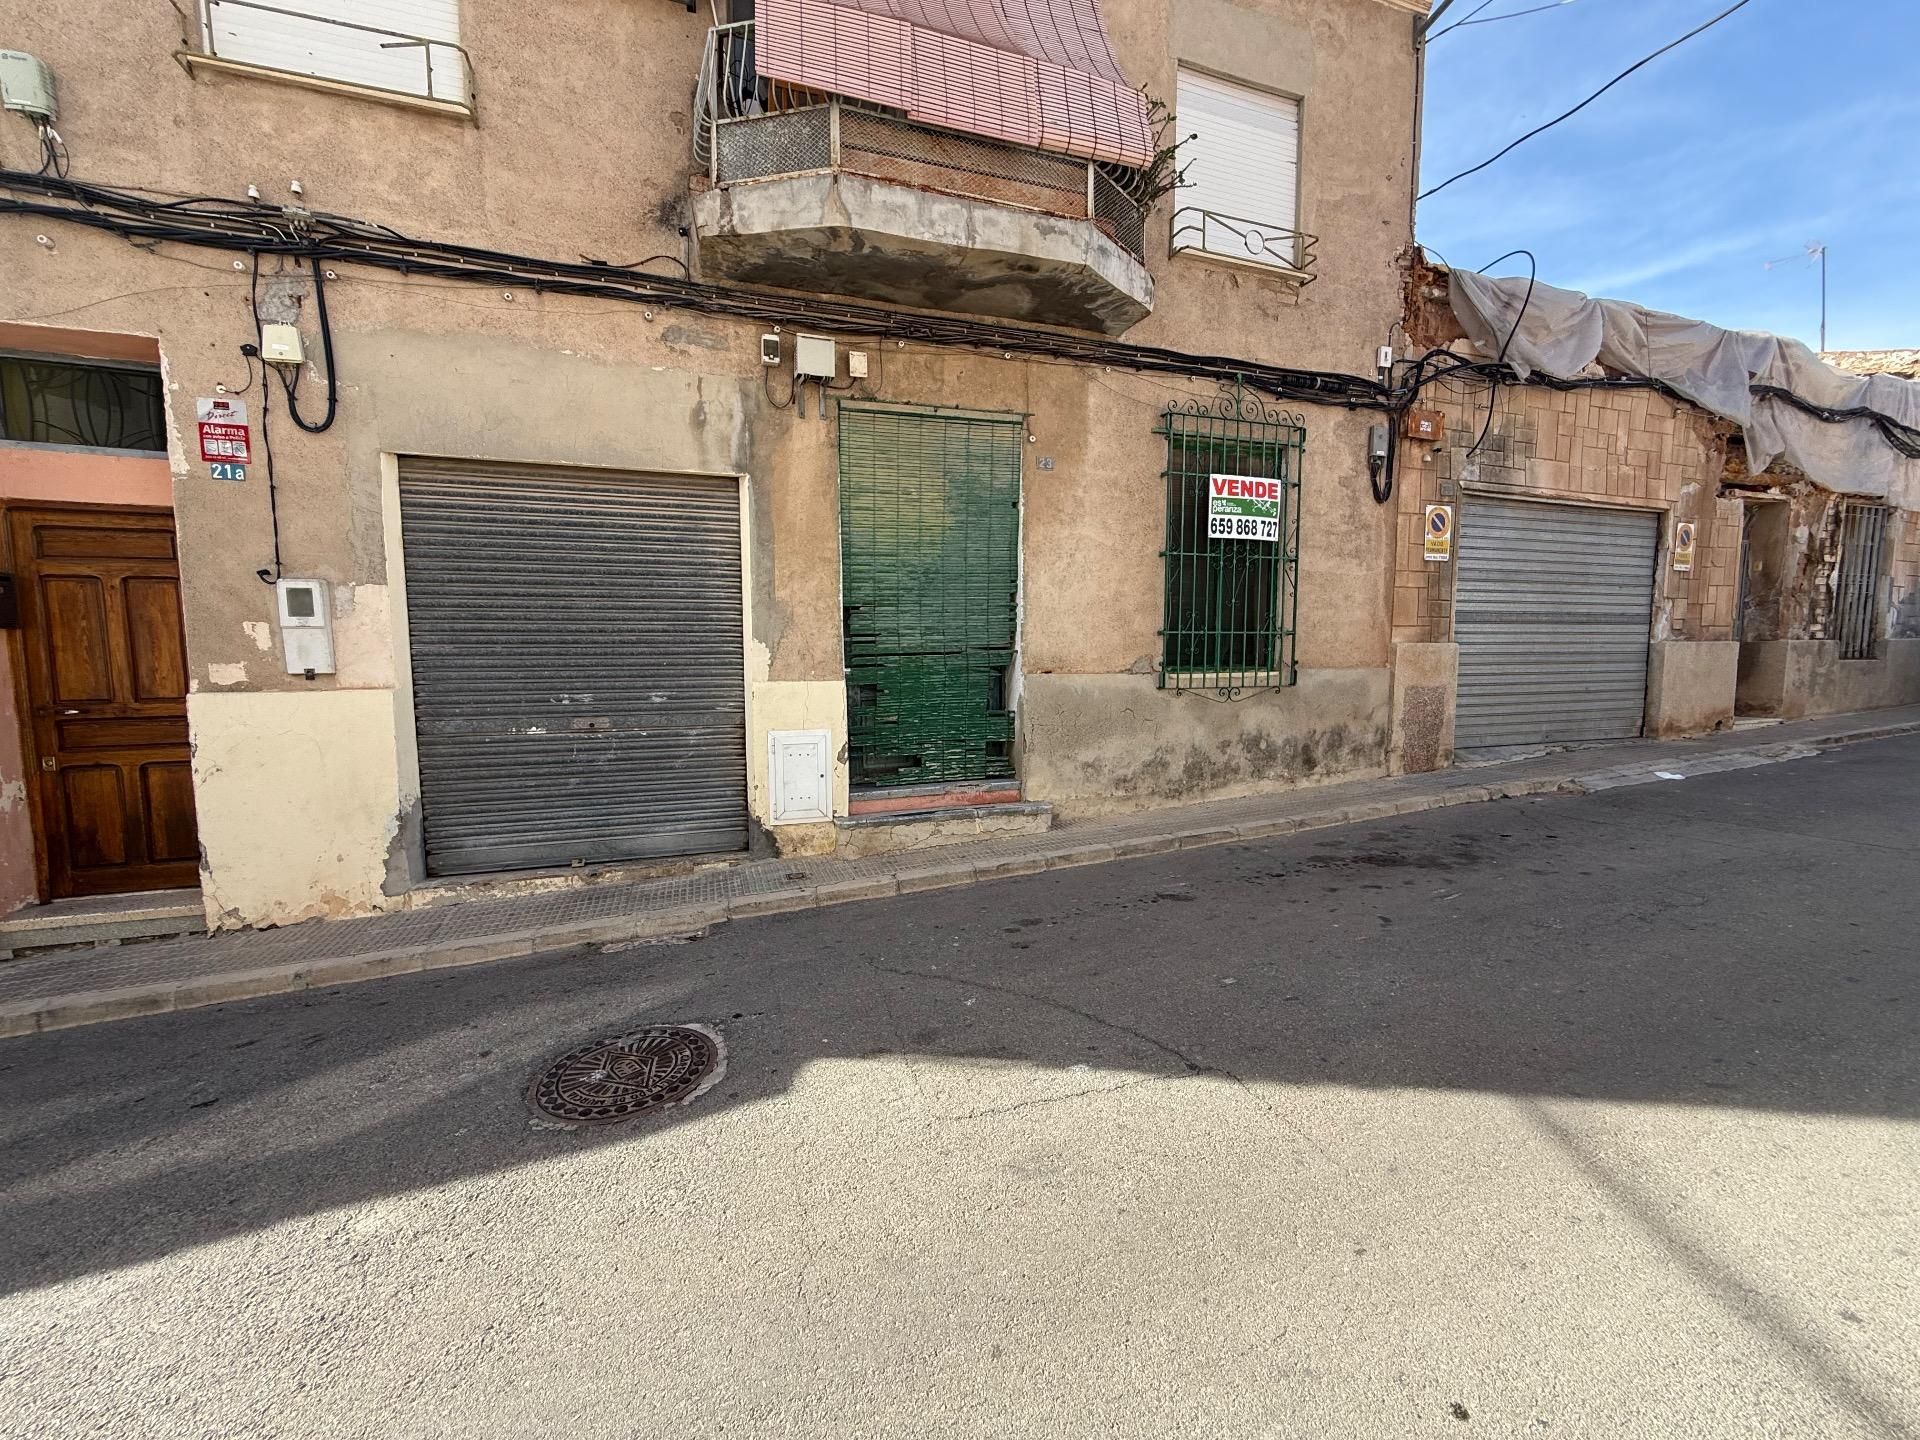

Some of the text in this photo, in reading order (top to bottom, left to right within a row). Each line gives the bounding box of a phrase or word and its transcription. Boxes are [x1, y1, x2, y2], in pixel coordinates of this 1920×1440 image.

[203, 425, 246, 436] Alarma
[1039, 457, 1052, 469] 23
[212, 464, 245, 480] 21a
[1212, 478, 1278, 500] VENDE
[1213, 505, 1242, 513] peranza
[1211, 518, 1277, 537] 659 868 727
